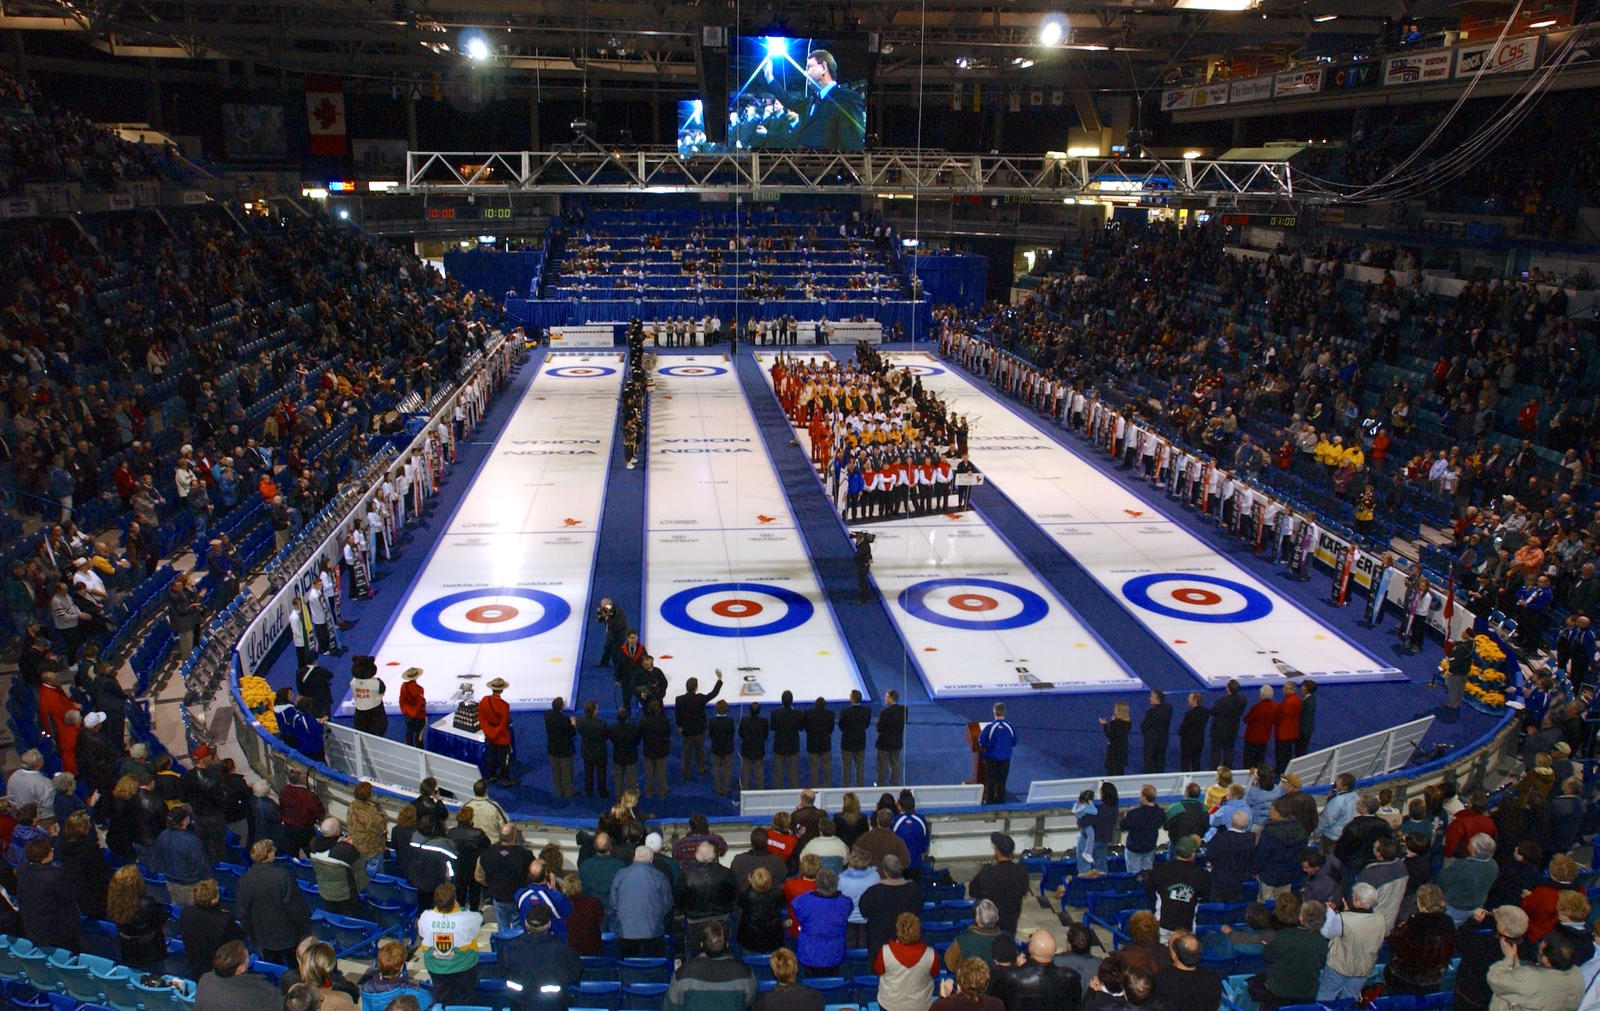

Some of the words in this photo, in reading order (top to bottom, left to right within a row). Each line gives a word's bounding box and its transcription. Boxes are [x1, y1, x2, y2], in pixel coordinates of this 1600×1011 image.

[1498, 43, 1525, 65] C95
[1335, 66, 1369, 85] CTV
[429, 208, 455, 218] 10:00
[484, 208, 510, 218] 10:00
[1269, 216, 1296, 226] 01:00
[1319, 533, 1373, 575] KÄRER
[294, 552, 325, 597] NOKI
[247, 604, 284, 673] Labatt
[431, 920, 456, 930] BROAD
